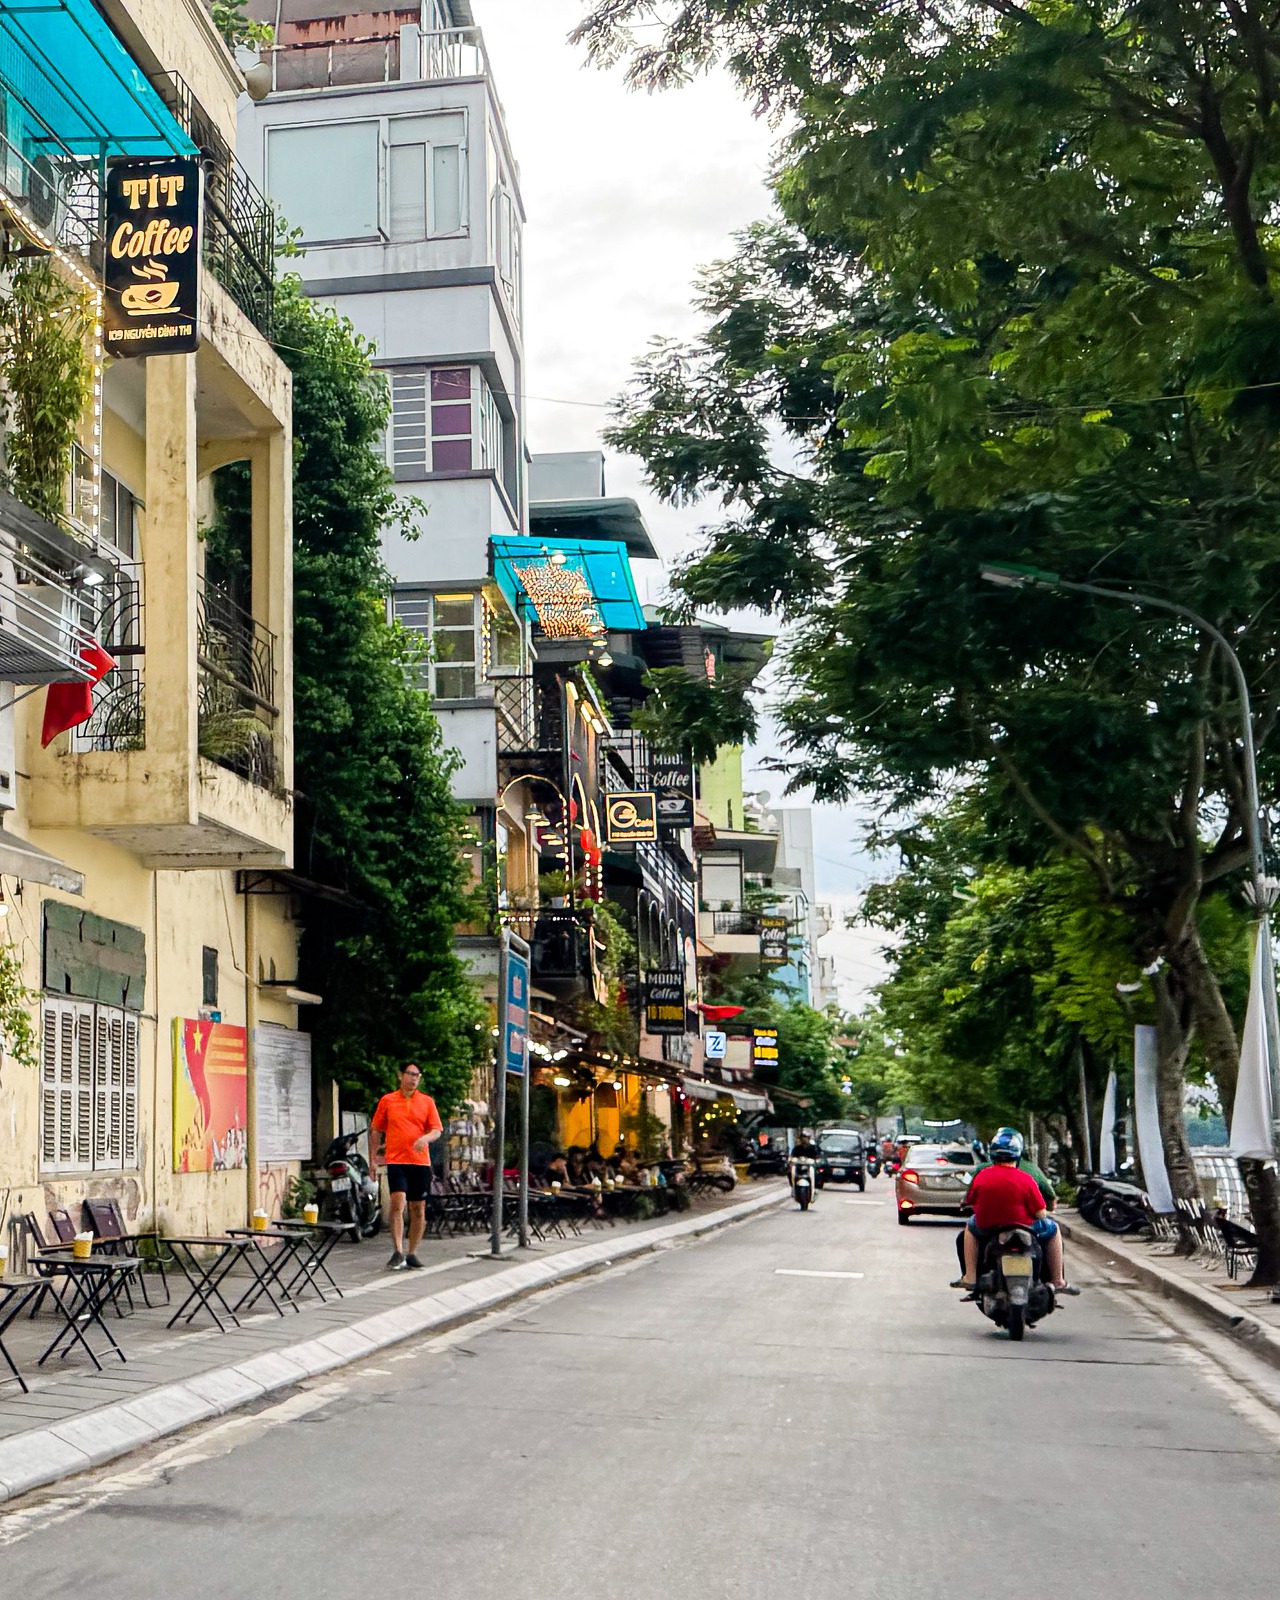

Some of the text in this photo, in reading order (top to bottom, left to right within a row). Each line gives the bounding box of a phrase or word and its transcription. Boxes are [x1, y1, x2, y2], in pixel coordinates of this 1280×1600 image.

[122, 173, 185, 210] TÍT
[111, 218, 194, 260] Coffee
[652, 770, 690, 788] Coffee
